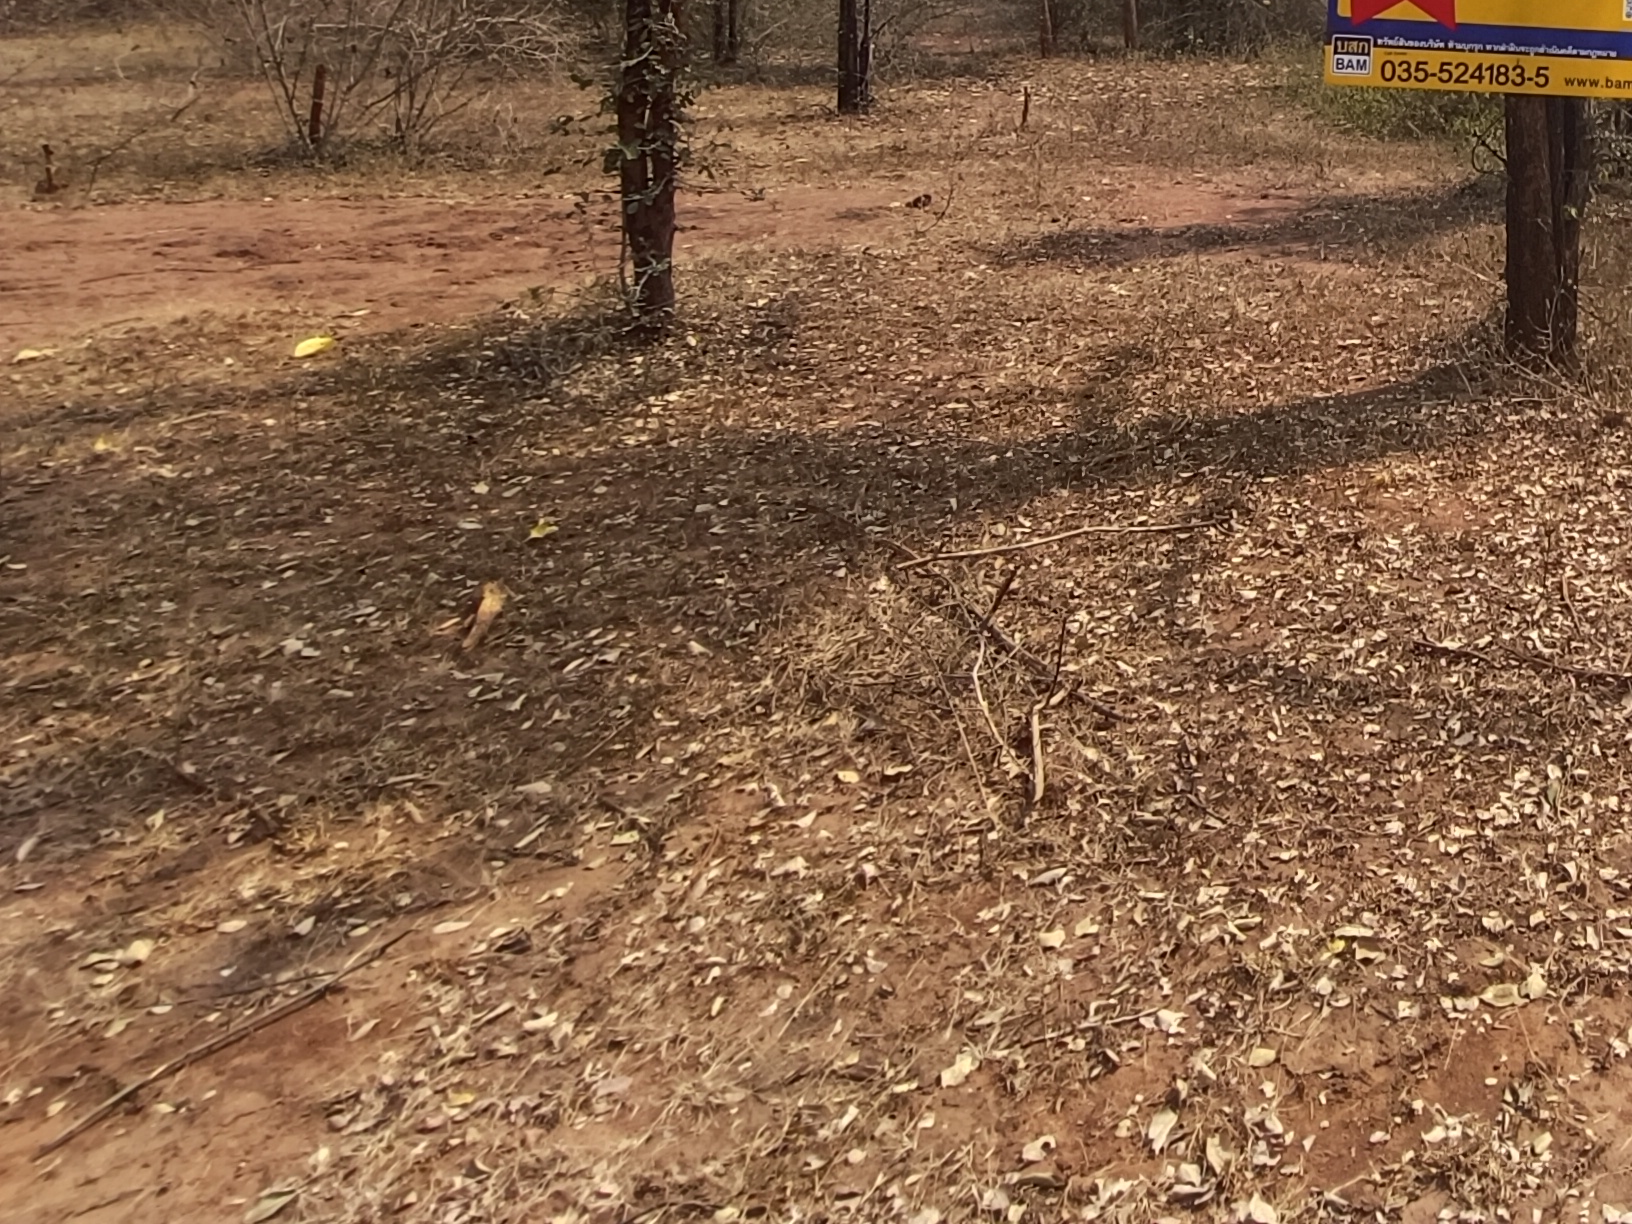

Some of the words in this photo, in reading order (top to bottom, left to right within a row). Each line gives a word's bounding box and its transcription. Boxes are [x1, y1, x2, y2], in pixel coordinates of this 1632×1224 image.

[1336, 40, 1369, 54] บสก
[1335, 57, 1368, 72] BAM
[1380, 59, 1550, 89] 035-524183-5
